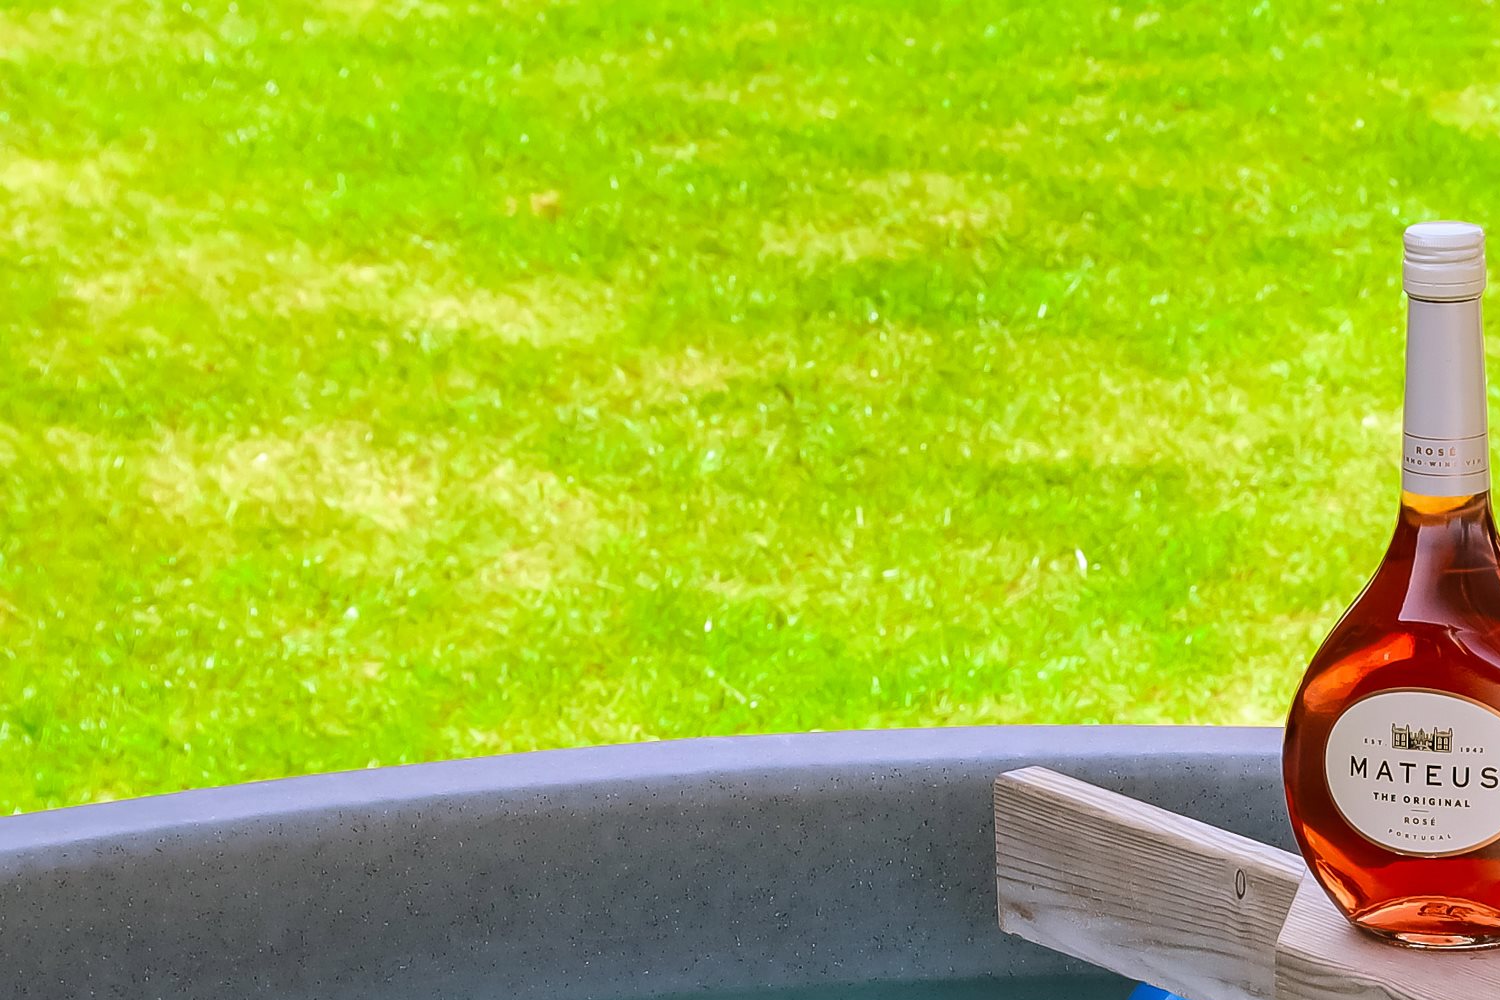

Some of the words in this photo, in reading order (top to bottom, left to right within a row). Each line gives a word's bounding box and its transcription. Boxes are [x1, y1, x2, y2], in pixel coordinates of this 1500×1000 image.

[1416, 446, 1456, 457] ROSÉ
[1350, 756, 1499, 789] MATEUS
[1373, 792, 1397, 803] THE
[1403, 795, 1471, 808] ORIGINAL
[1404, 816, 1436, 826] ROSÉ
[1388, 828, 1452, 841] PORTUGAL
